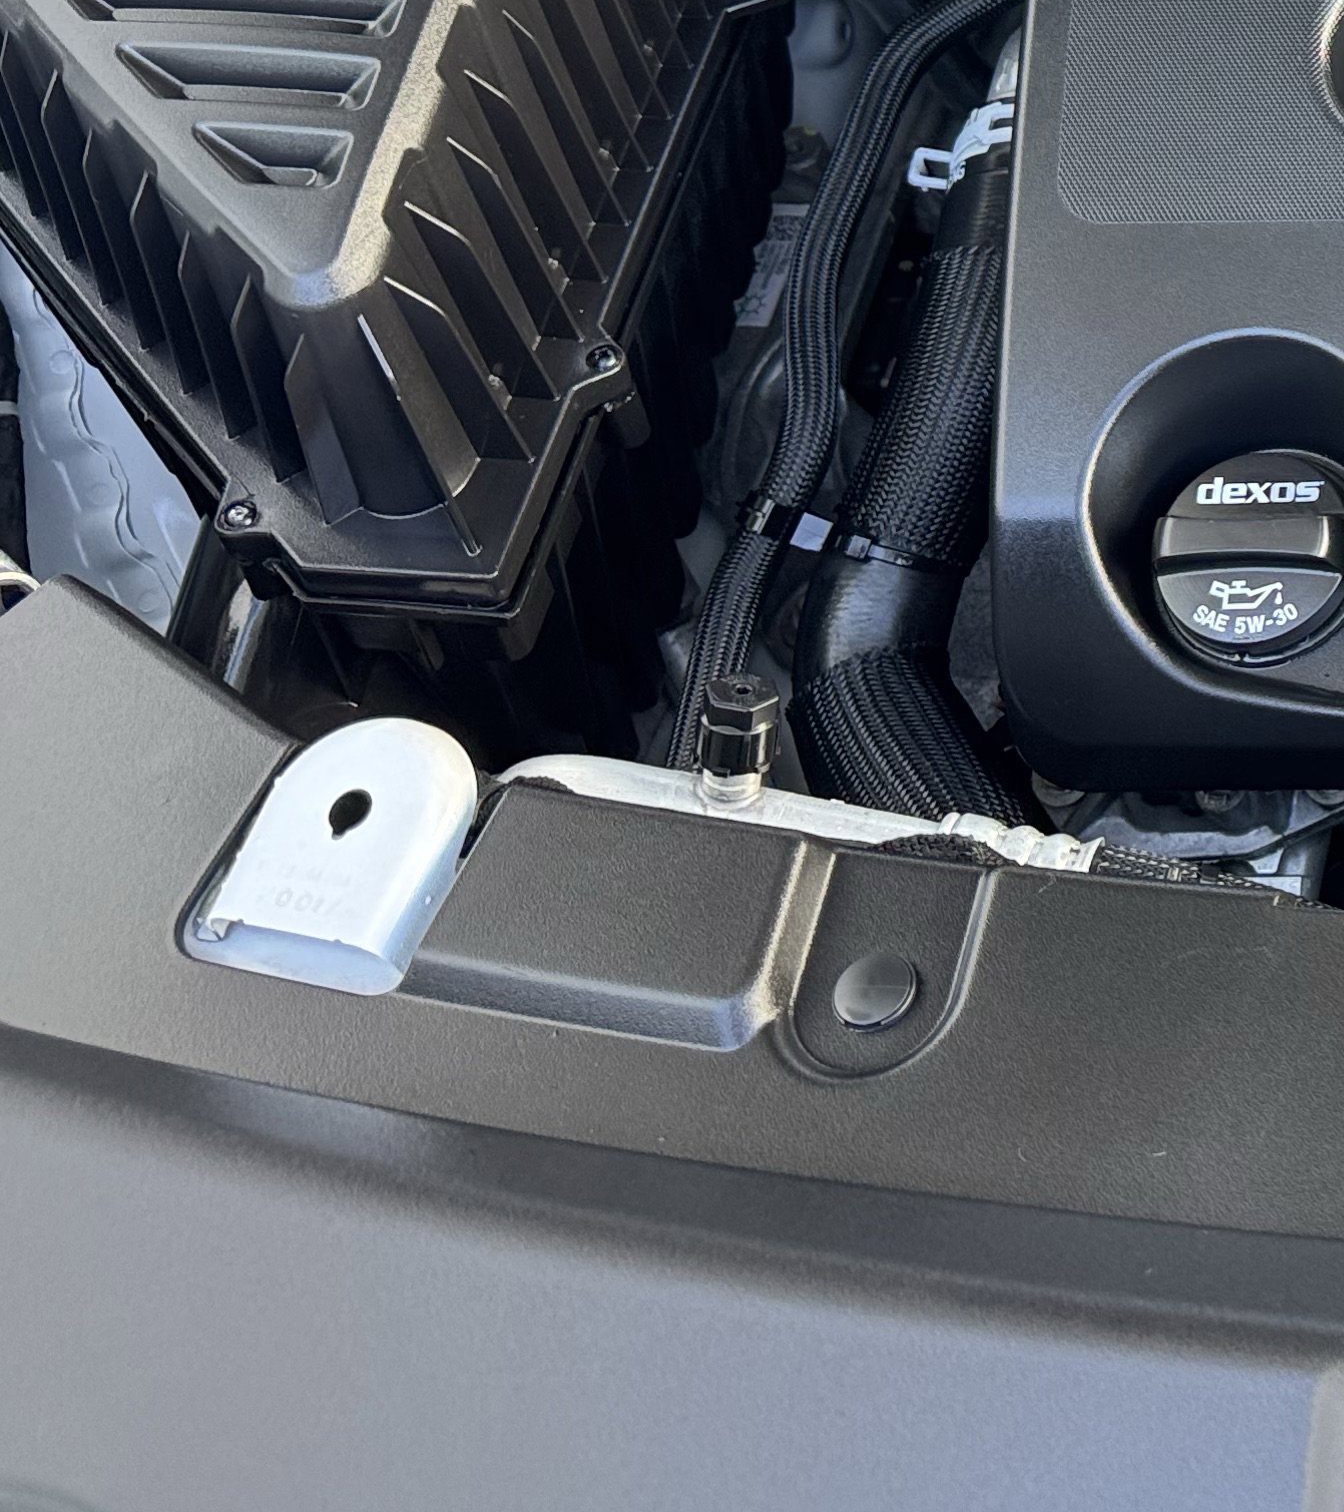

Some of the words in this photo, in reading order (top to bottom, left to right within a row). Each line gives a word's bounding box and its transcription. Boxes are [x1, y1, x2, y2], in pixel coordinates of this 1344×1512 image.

[1196, 476, 1322, 505] dexos
[1192, 604, 1231, 634] SAE
[1234, 602, 1299, 635] 5W-30
